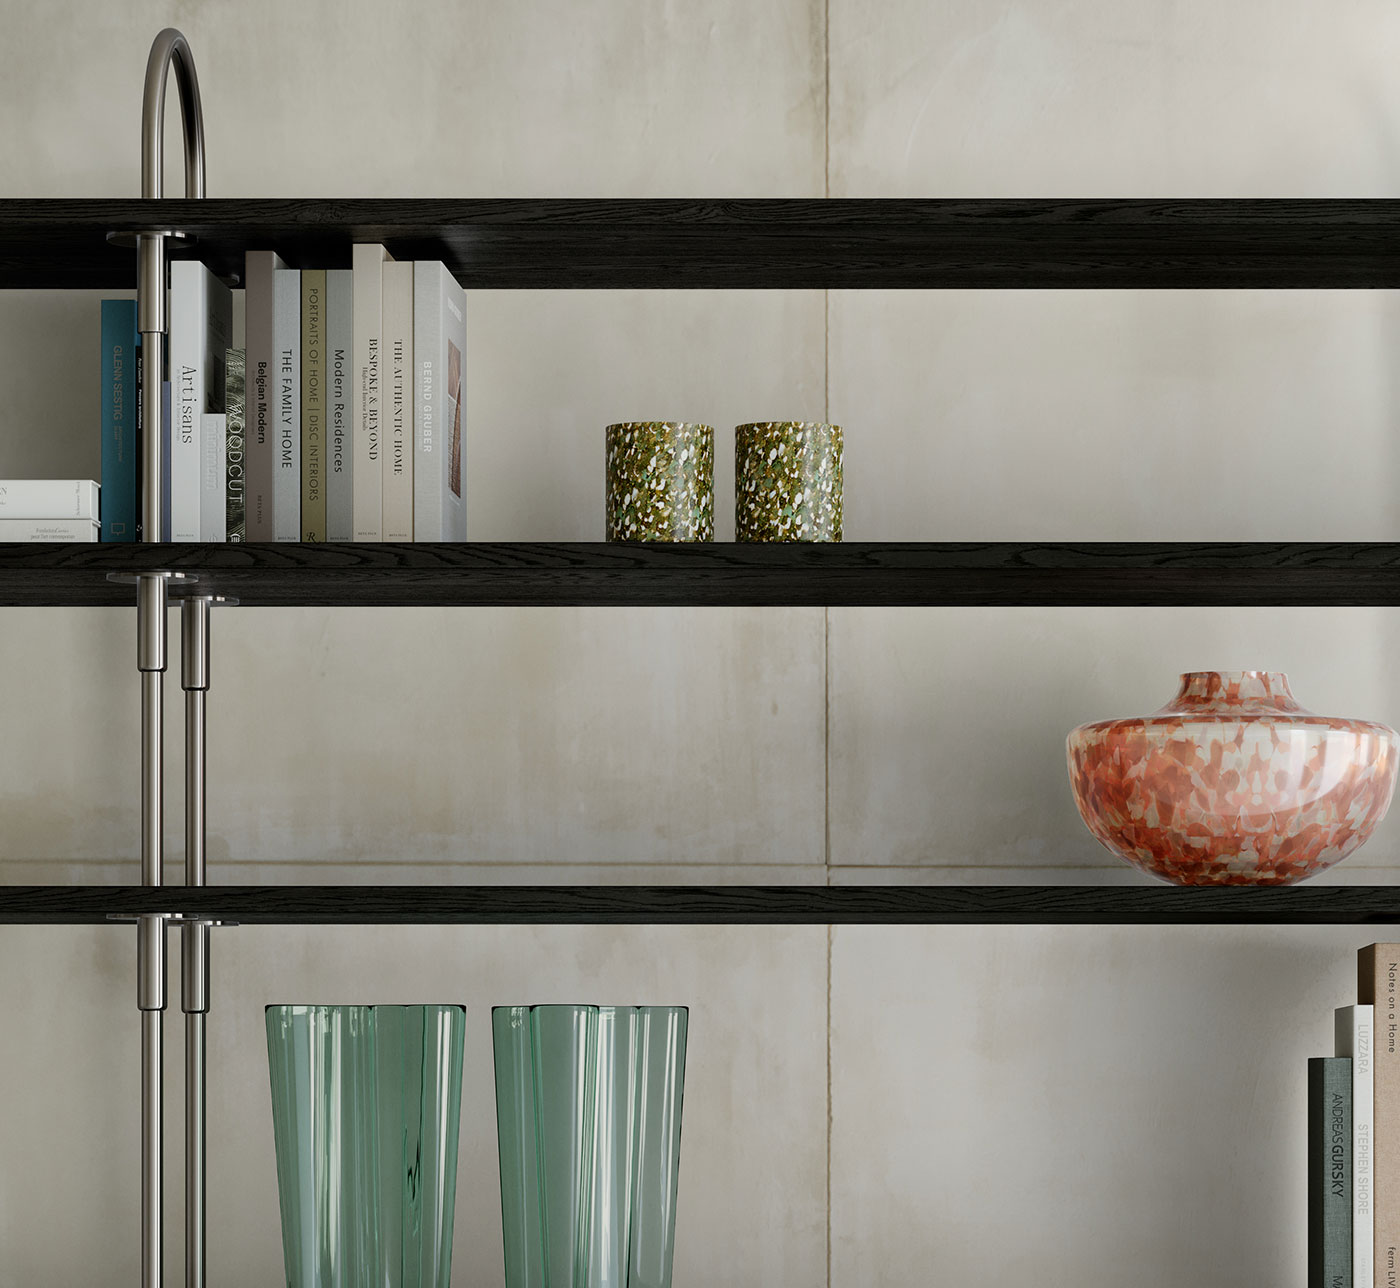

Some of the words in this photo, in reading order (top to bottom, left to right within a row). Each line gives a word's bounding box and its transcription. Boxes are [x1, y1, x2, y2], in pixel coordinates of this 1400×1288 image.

[308, 288, 319, 345] PORTRAITS
[113, 345, 123, 381] GLENN
[282, 348, 293, 373] THE
[308, 350, 319, 365] OF
[368, 338, 379, 394] BESPOKE
[394, 338, 403, 364] THE
[256, 361, 267, 401] Belgian
[308, 369, 319, 403] HOME
[334, 349, 345, 398] Modern
[422, 361, 432, 401] BERND
[113, 383, 123, 421] SESTIG
[181, 365, 197, 444] Artisans
[282, 378, 293, 425] FAMILY
[368, 397, 379, 405] &
[394, 366, 403, 437] AUTHENTIC
[257, 402, 267, 444] Modern
[308, 415, 319, 440] DISC
[334, 403, 345, 473] Residences
[368, 409, 379, 461] BEYOND
[422, 405, 432, 453] GRUBER
[228, 404, 243, 504] WOODCUT
[282, 430, 293, 468] HOME
[394, 440, 403, 476] HOME
[308, 445, 319, 502] INTERIORS
[1388, 962, 1398, 993] Notes
[1388, 997, 1398, 1010] on
[1357, 1024, 1369, 1075] LUZZARA
[1388, 1024, 1398, 1053] Home
[1357, 1123, 1369, 1173] STEPHEN
[1331, 1144, 1344, 1198] GURSKY
[1357, 1176, 1369, 1215] SHORE
[1387, 1246, 1396, 1268] ferm
